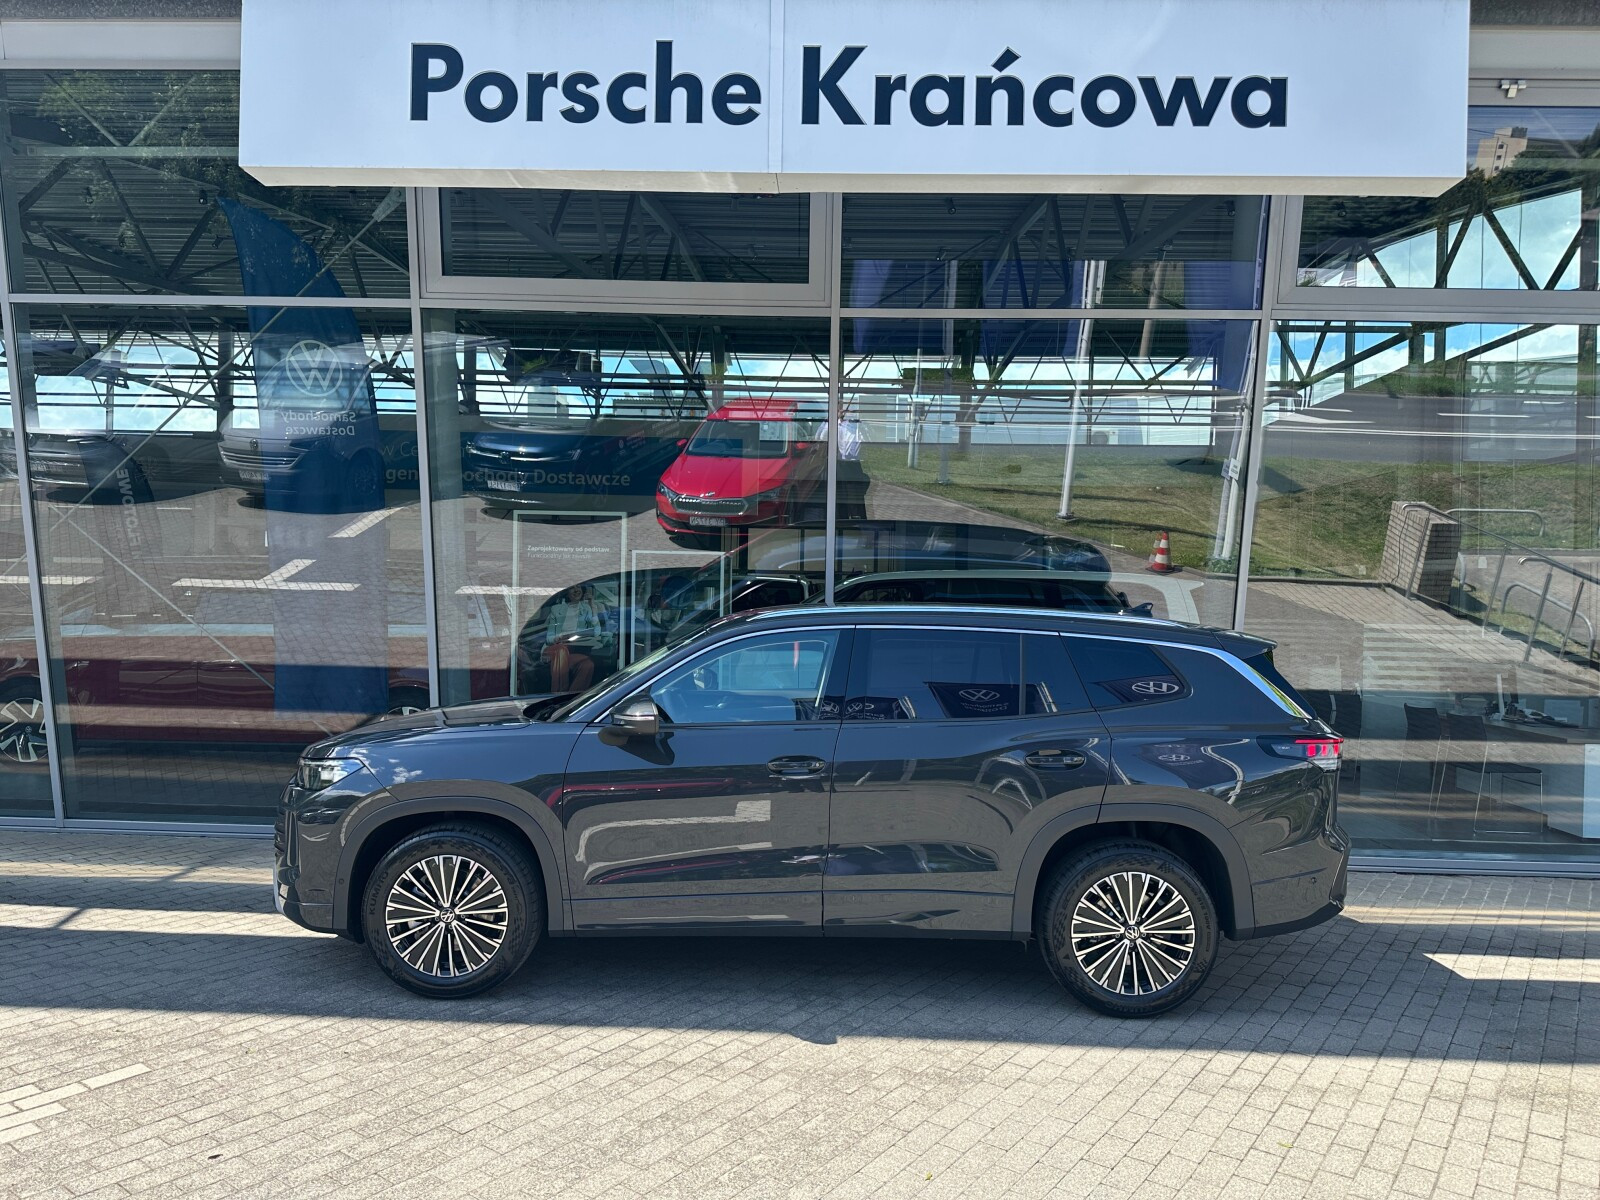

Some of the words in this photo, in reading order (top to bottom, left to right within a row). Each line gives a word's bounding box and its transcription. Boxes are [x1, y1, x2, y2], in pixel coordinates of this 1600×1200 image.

[410, 40, 762, 126] Porsche
[800, 44, 1288, 129] Krańcowa
[533, 468, 631, 487] Dostawcze
[527, 544, 574, 553] Zaprojektowany
[370, 870, 388, 916] KUMHO
